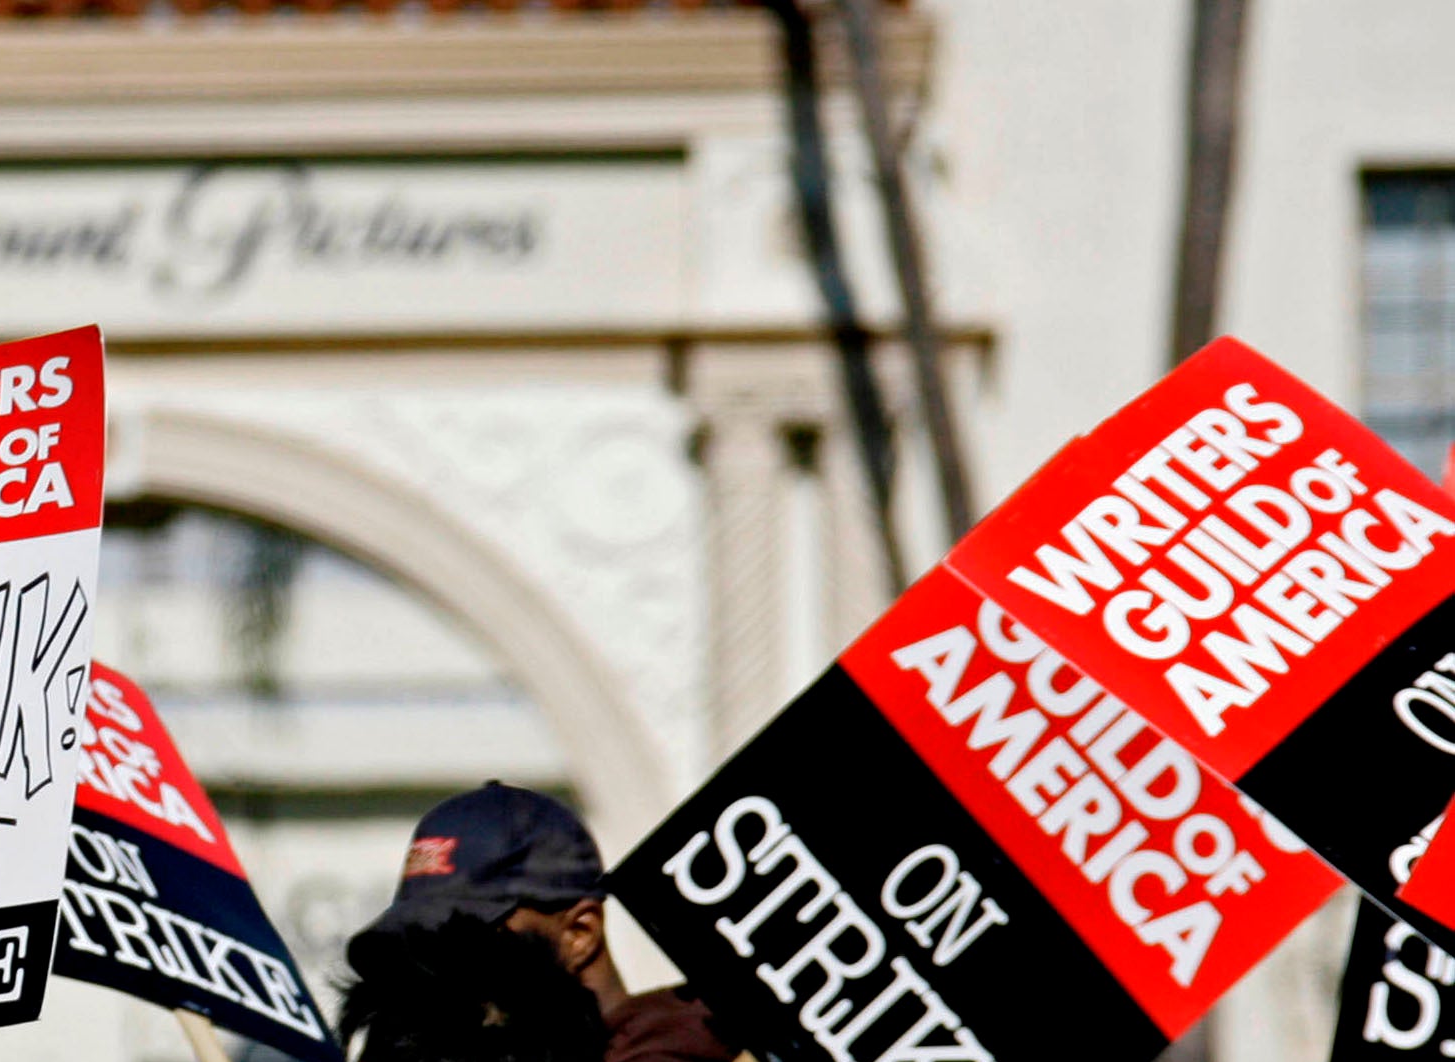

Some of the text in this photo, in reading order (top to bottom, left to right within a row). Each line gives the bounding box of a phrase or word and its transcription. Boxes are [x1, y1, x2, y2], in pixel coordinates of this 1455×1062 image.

[1006, 382, 1304, 616] WRITERS
[1102, 448, 1368, 660] GUILD OF
[1164, 488, 1455, 737] AMERICA
[69, 823, 159, 898] ON
[891, 624, 1223, 988] AMERICA
[1172, 813, 1267, 897] OF
[60, 879, 326, 1041] TRIKE
[880, 844, 1010, 967] ON
